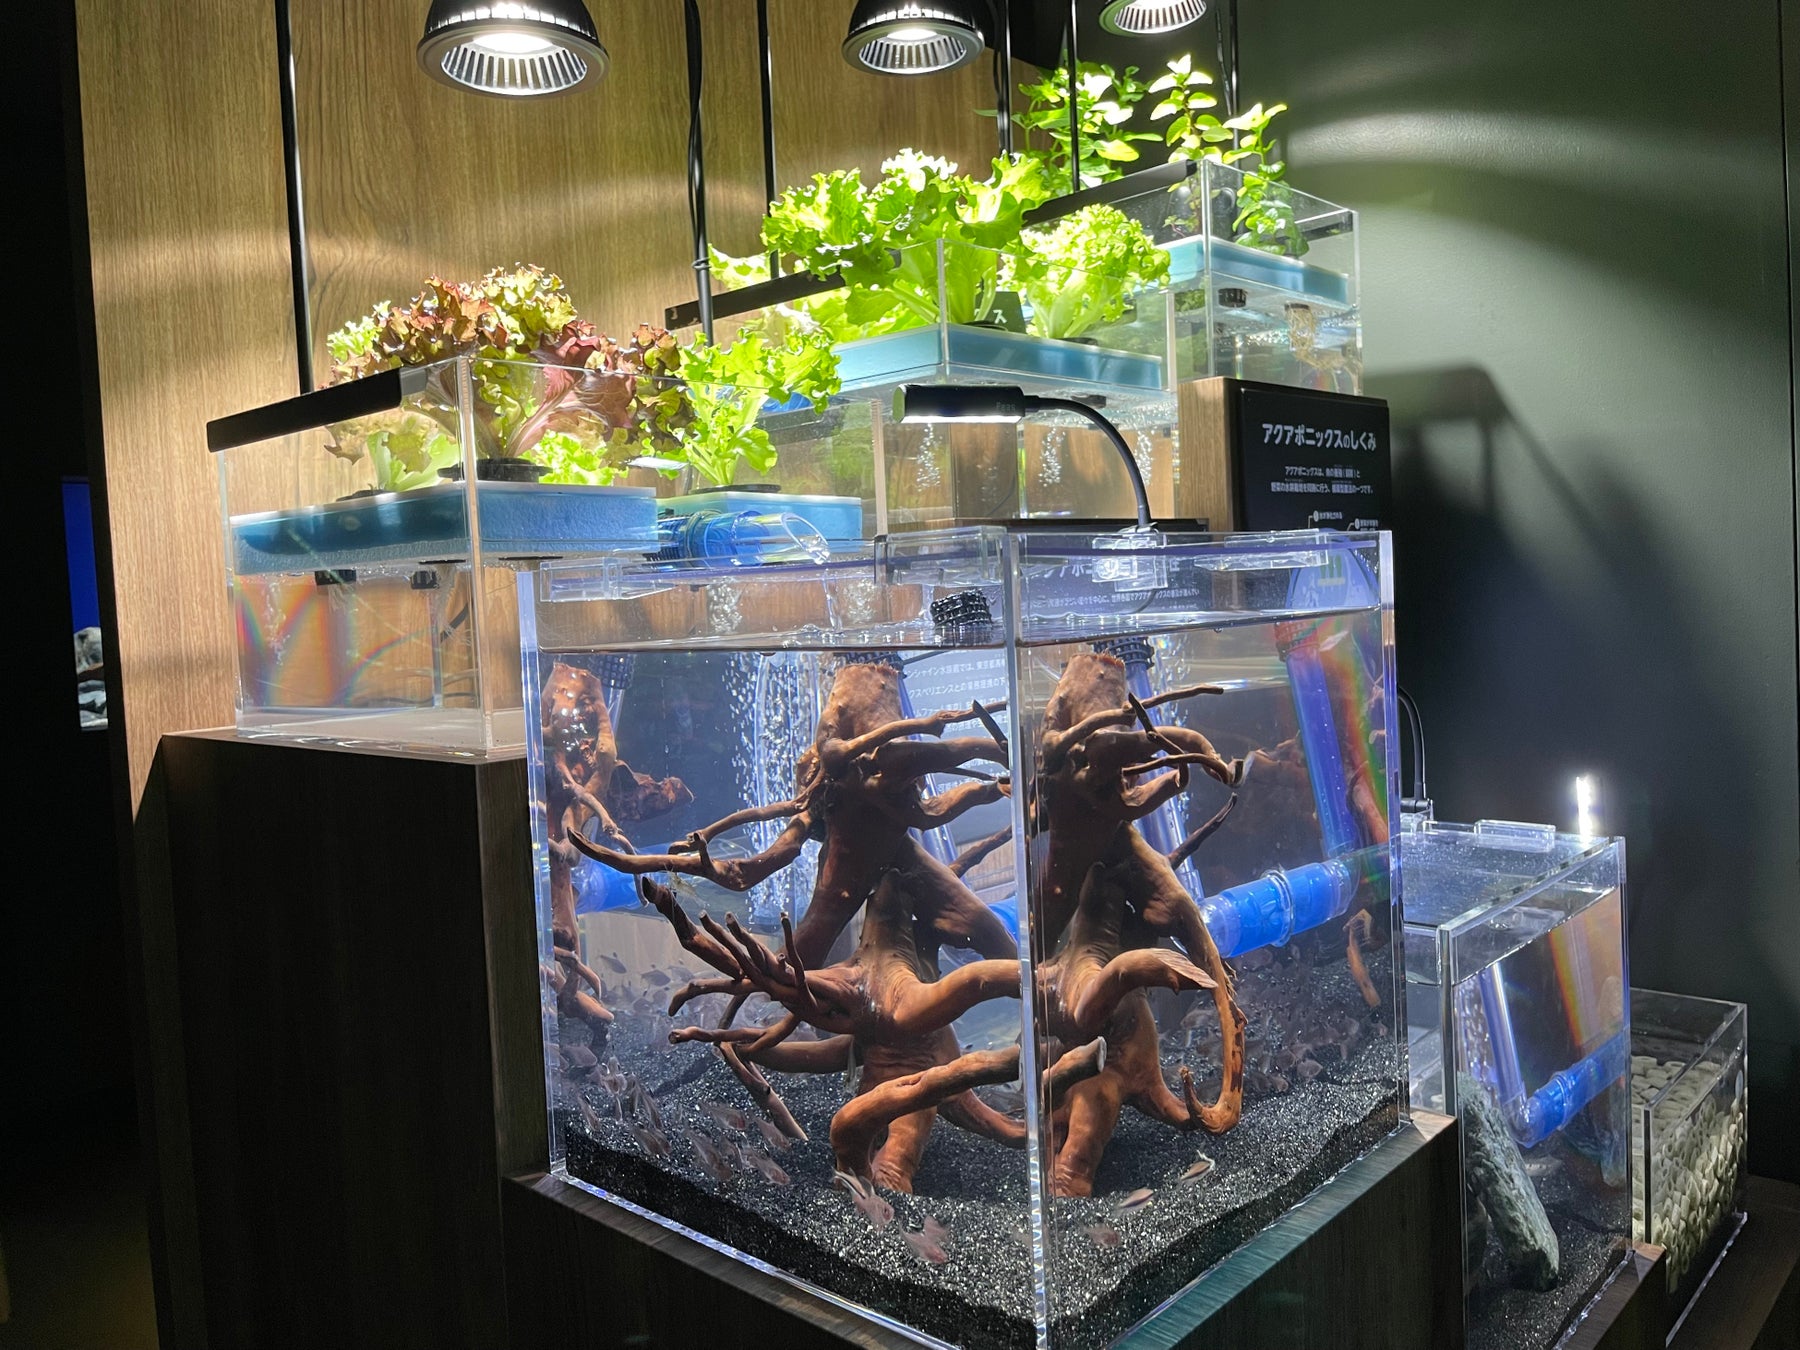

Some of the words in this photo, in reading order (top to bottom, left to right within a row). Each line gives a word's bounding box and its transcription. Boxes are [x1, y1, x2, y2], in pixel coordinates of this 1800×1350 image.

[1262, 423, 1377, 451] アクアポニックスのしくみ
